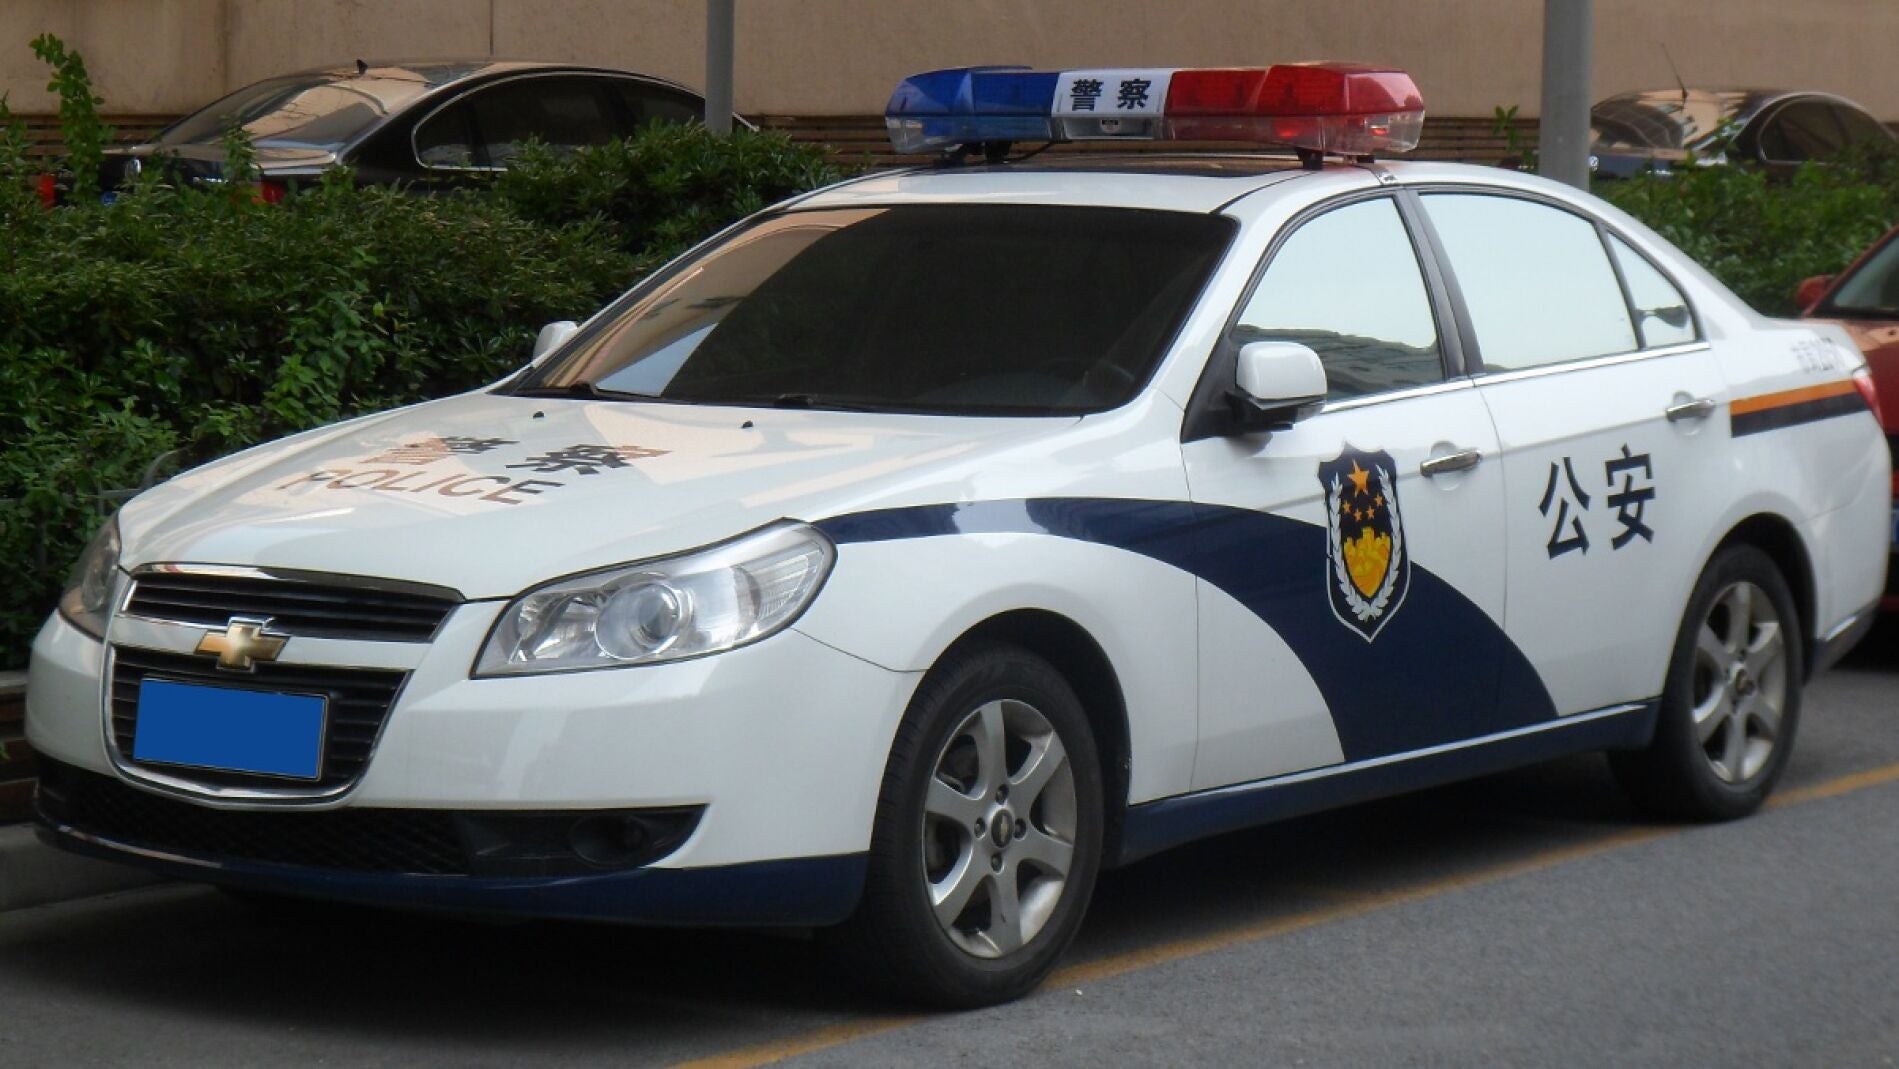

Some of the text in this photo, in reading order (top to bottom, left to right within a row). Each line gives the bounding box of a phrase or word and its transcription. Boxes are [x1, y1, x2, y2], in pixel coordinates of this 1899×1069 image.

[1070, 79, 1152, 111] 警察
[358, 436, 673, 475] 警察
[276, 468, 566, 505] POLICE
[1538, 443, 1656, 560] 公安
